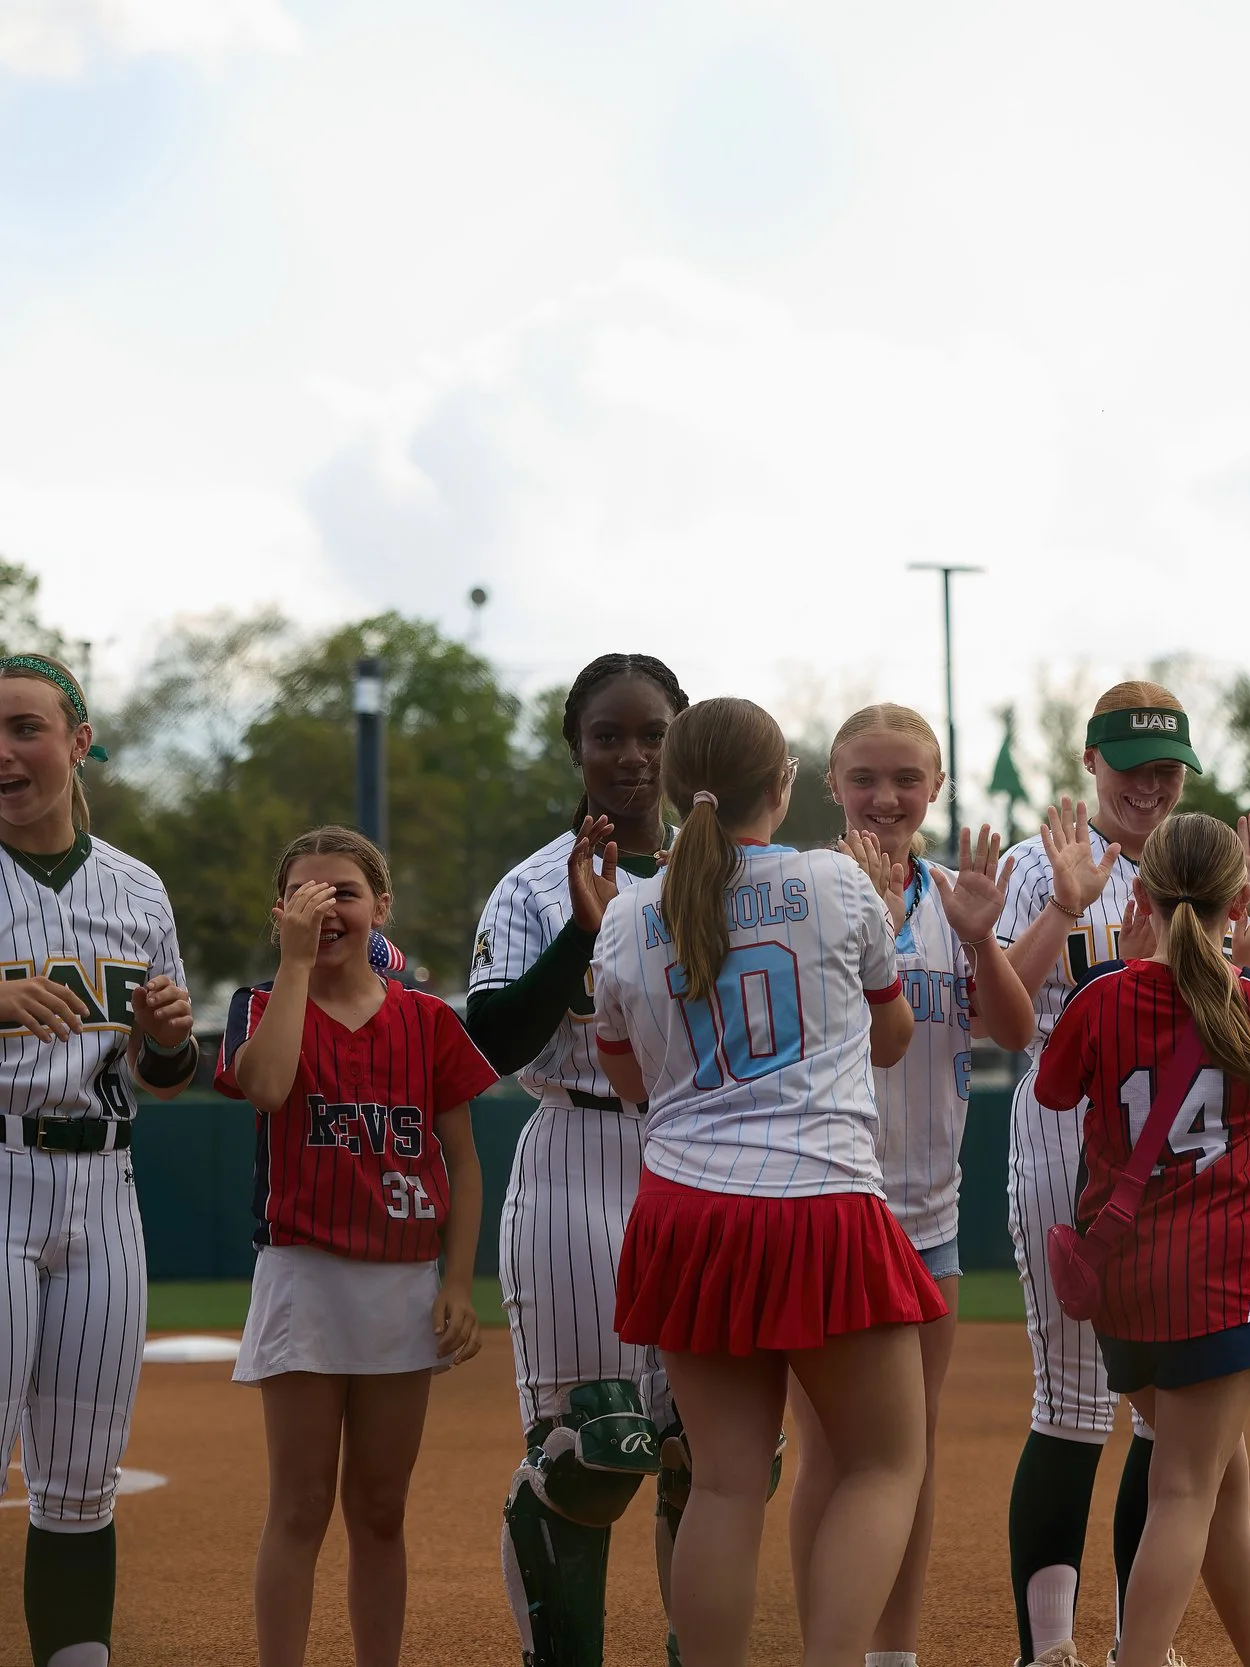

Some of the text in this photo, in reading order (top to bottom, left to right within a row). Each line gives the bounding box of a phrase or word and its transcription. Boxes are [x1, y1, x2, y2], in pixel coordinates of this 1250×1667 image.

[1130, 713, 1178, 732] UAB
[642, 878, 809, 950] NOLS
[664, 940, 805, 1091] 10
[306, 1093, 423, 1159] REVS
[1117, 1066, 1232, 1177] 14
[382, 1171, 437, 1219] 32
